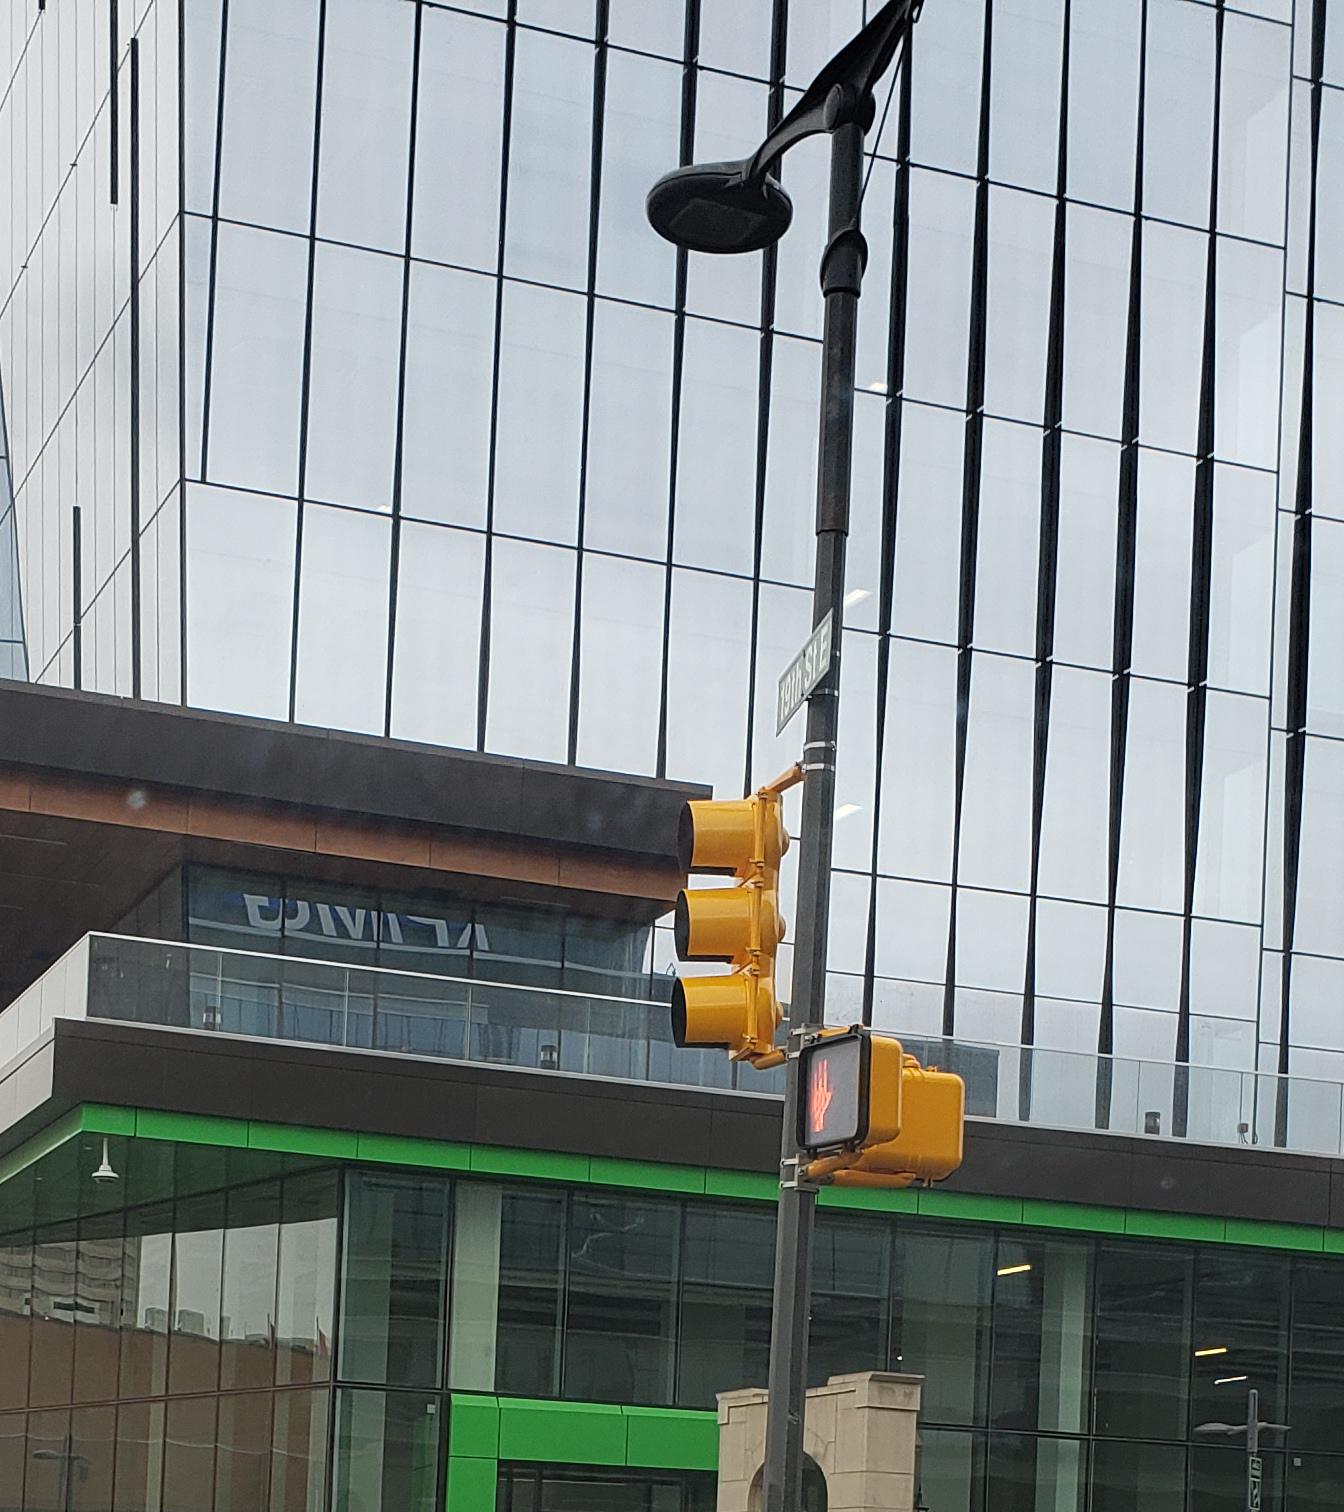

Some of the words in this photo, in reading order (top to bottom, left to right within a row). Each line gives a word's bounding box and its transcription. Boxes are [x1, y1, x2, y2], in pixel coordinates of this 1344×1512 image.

[780, 662, 802, 721] 19th
[804, 643, 817, 689] St
[819, 624, 829, 671] E
